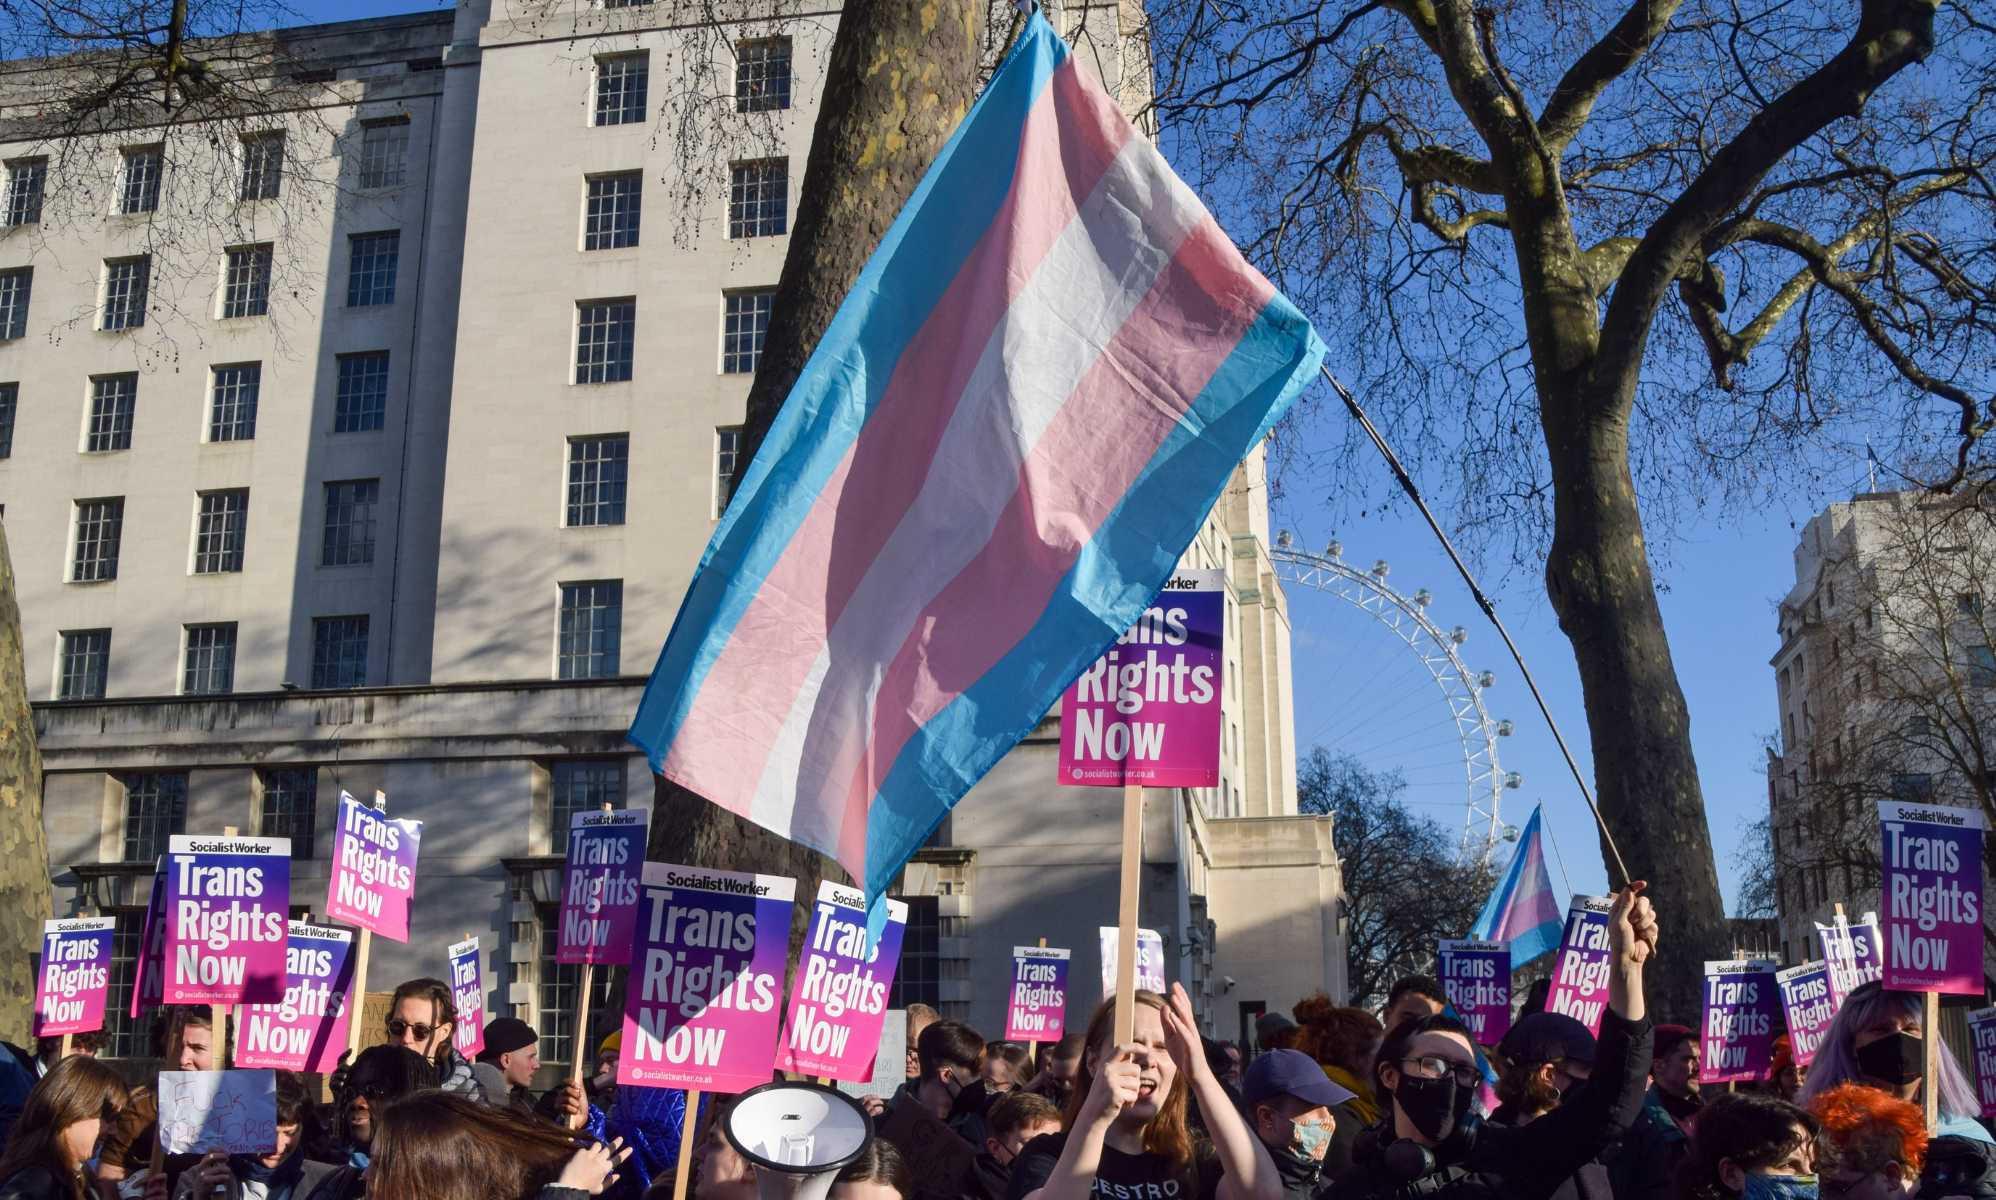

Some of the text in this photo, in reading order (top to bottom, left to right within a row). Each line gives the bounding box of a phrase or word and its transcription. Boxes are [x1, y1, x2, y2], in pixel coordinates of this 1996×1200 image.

[1077, 650, 1214, 714] Rights
[1074, 708, 1166, 761] Now
[345, 798, 400, 851] Trans
[341, 834, 411, 890] Rights
[572, 829, 629, 866] Trans
[1886, 822, 1960, 874] Trans
[174, 855, 264, 897] Trans
[337, 869, 383, 918] Now
[568, 868, 638, 914] Rights
[832, 890, 865, 910] Socialis
[1891, 873, 1978, 931] Rights
[177, 900, 283, 951] Rights
[563, 909, 611, 946] Now
[646, 889, 757, 952] Trans
[47, 933, 99, 962] Trans
[175, 945, 247, 986] Now
[286, 947, 333, 978] ans
[1441, 952, 1495, 978] Trans
[1891, 923, 1949, 972] Now
[45, 962, 107, 998] Rights
[452, 959, 476, 987] Trans
[641, 948, 776, 1019] Rights
[801, 953, 886, 1018] Rights
[1016, 957, 1056, 982] Trans
[1560, 949, 1612, 996] Righ
[42, 995, 85, 1023] Now
[1014, 983, 1063, 1011] Rights
[1444, 979, 1507, 1011] Rights
[1708, 976, 1758, 1005] Trans
[1781, 978, 1827, 1005] Trans
[789, 1003, 851, 1058] Now
[1012, 1008, 1046, 1031] Now
[1708, 1007, 1769, 1043] Rights
[1789, 998, 1834, 1030] Right
[247, 1015, 311, 1054] Now
[458, 1020, 477, 1049] Now
[634, 1007, 726, 1067] Now
[1707, 1040, 1747, 1069] Now
